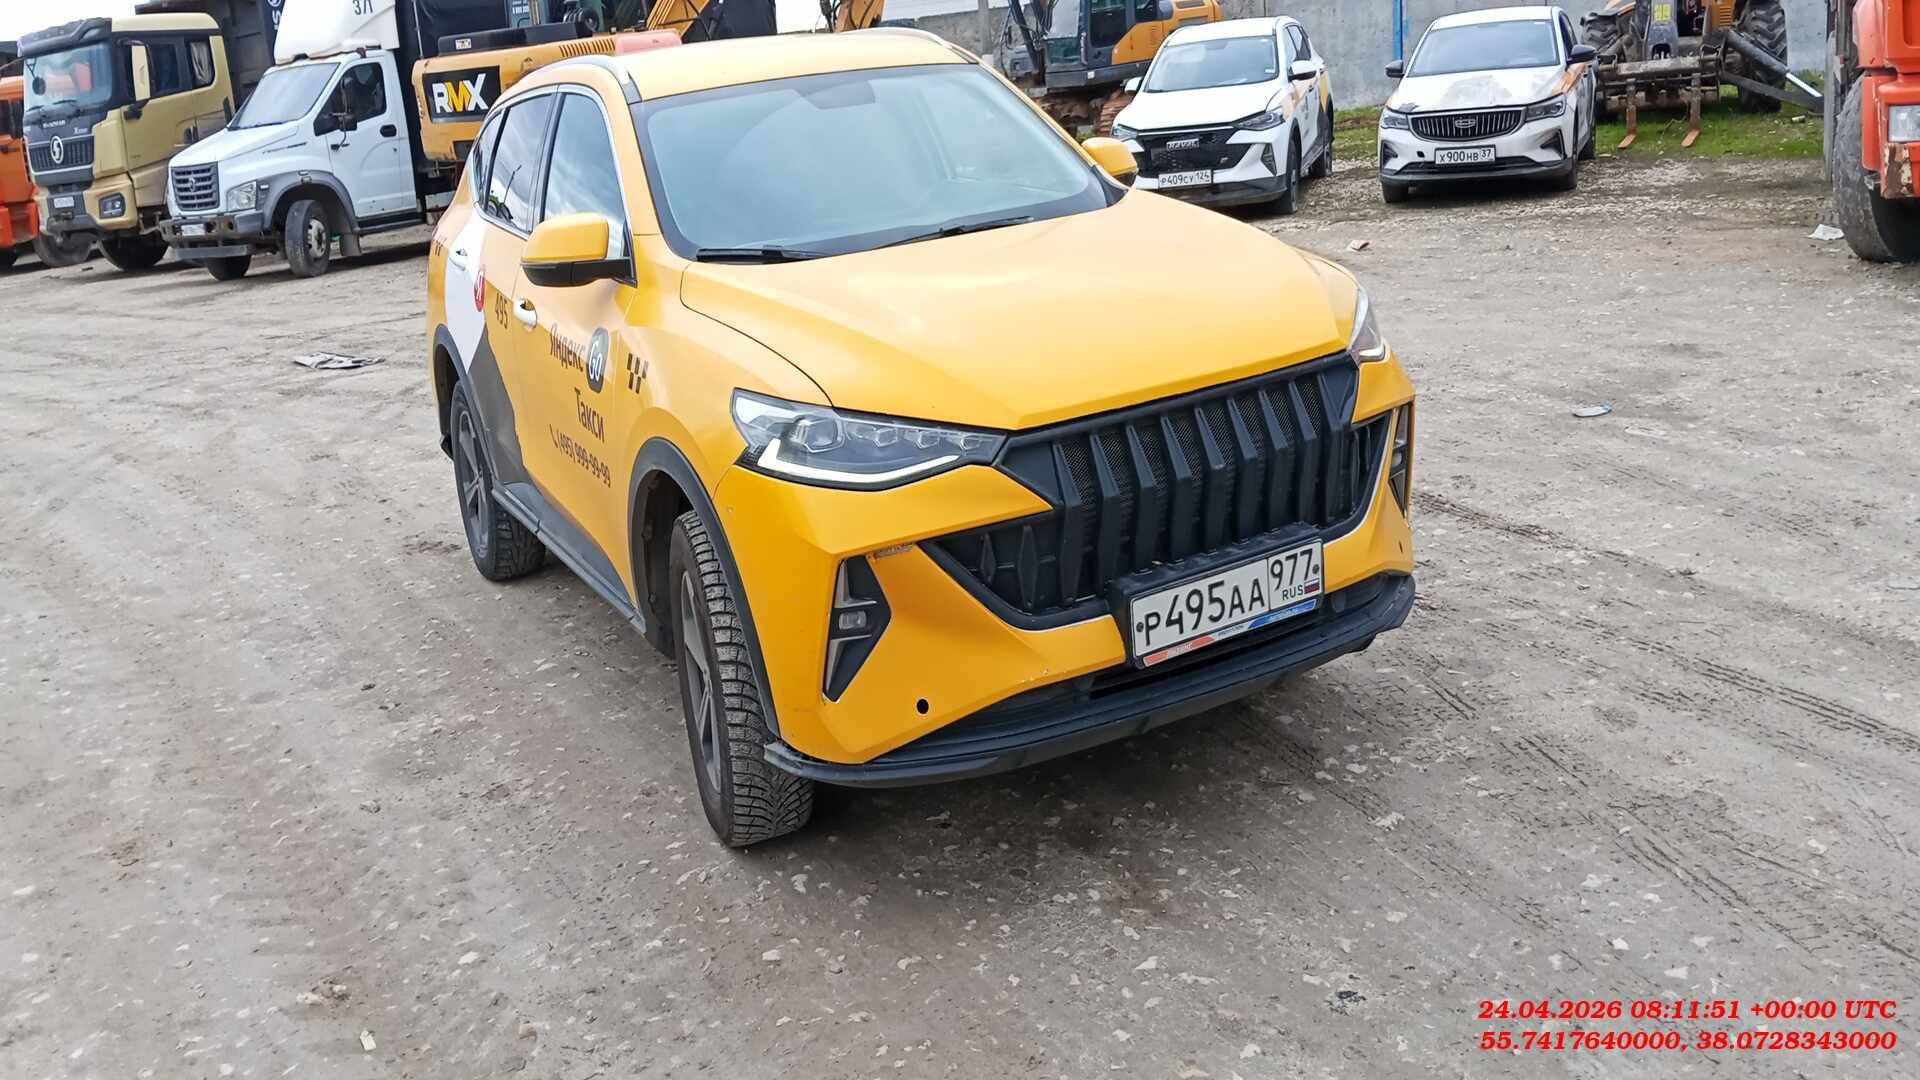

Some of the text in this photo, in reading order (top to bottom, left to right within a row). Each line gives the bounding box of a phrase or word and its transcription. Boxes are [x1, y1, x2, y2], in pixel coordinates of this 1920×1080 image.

[432, 73, 488, 114] RMX
[494, 292, 509, 330] 495
[550, 322, 585, 373] Яндекс
[588, 340, 603, 383] Go
[574, 386, 605, 443] Такси
[556, 428, 611, 489] (495) 999-99-99
[1270, 548, 1314, 592] 977
[1281, 584, 1304, 601] RUS
